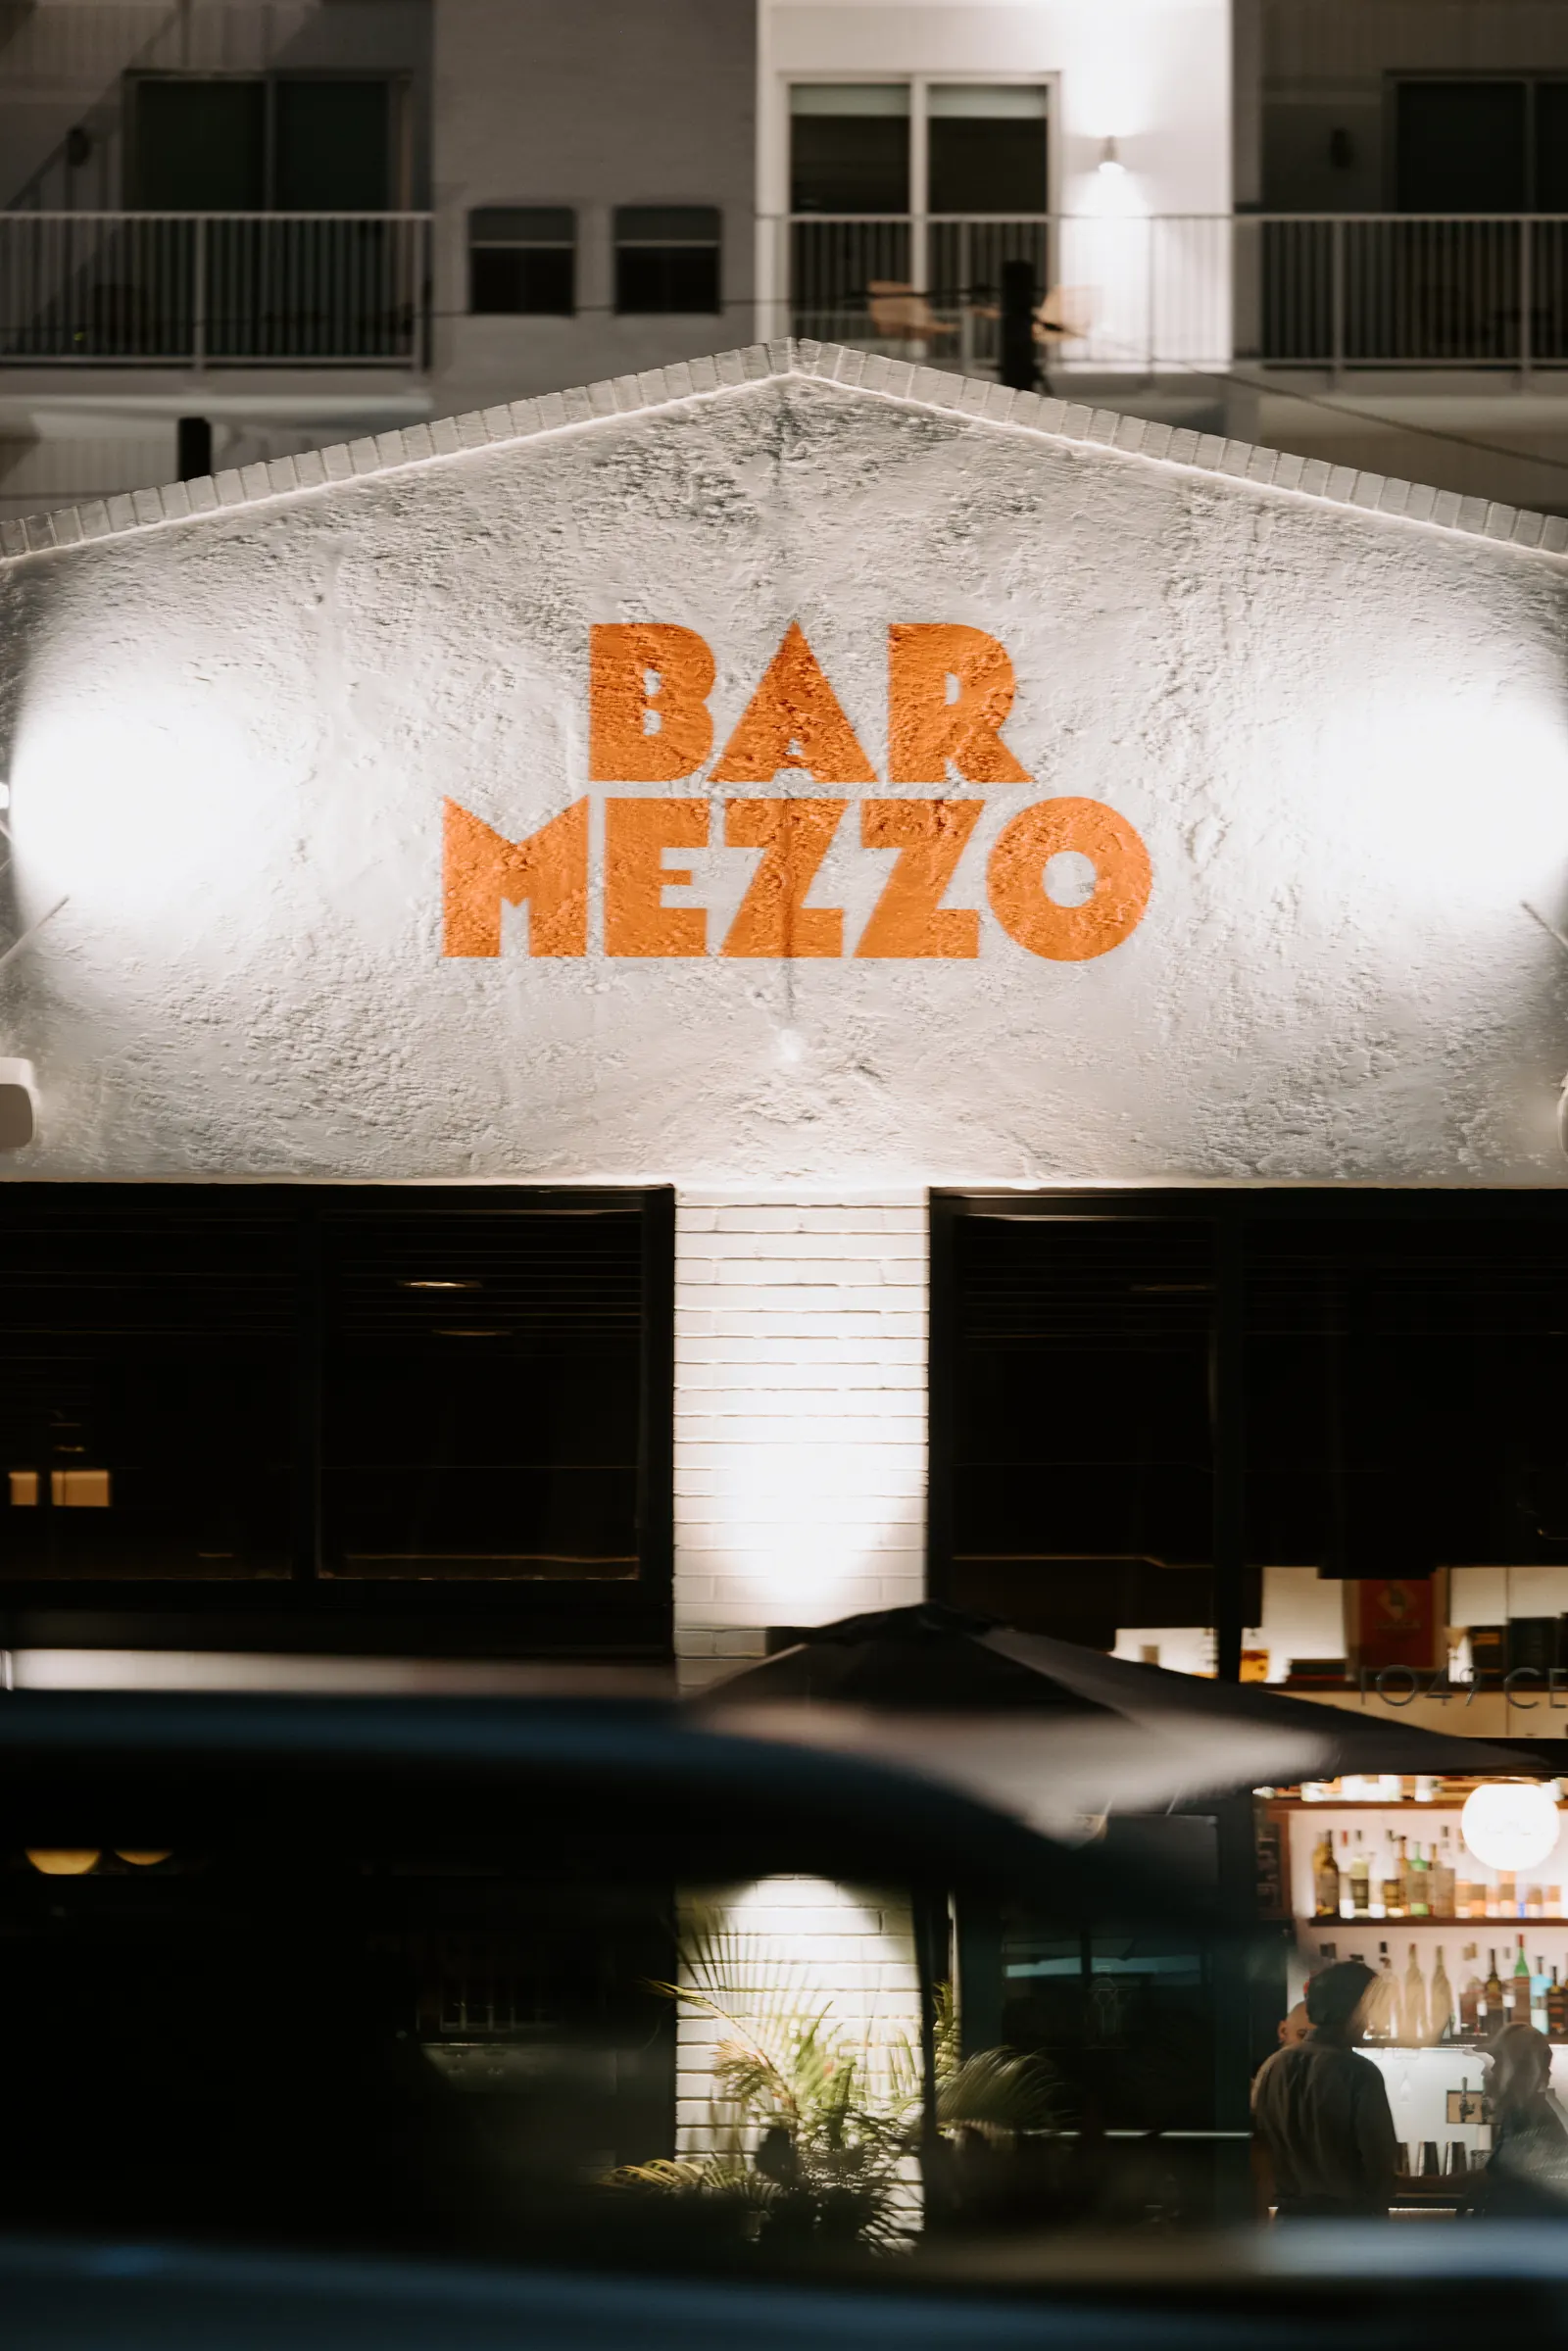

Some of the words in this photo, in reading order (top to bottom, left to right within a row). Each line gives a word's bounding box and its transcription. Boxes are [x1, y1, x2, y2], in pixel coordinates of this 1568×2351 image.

[588, 621, 1033, 783] BAR
[443, 796, 1152, 960] MEZZO
[1361, 1665, 1482, 1707] 1049
